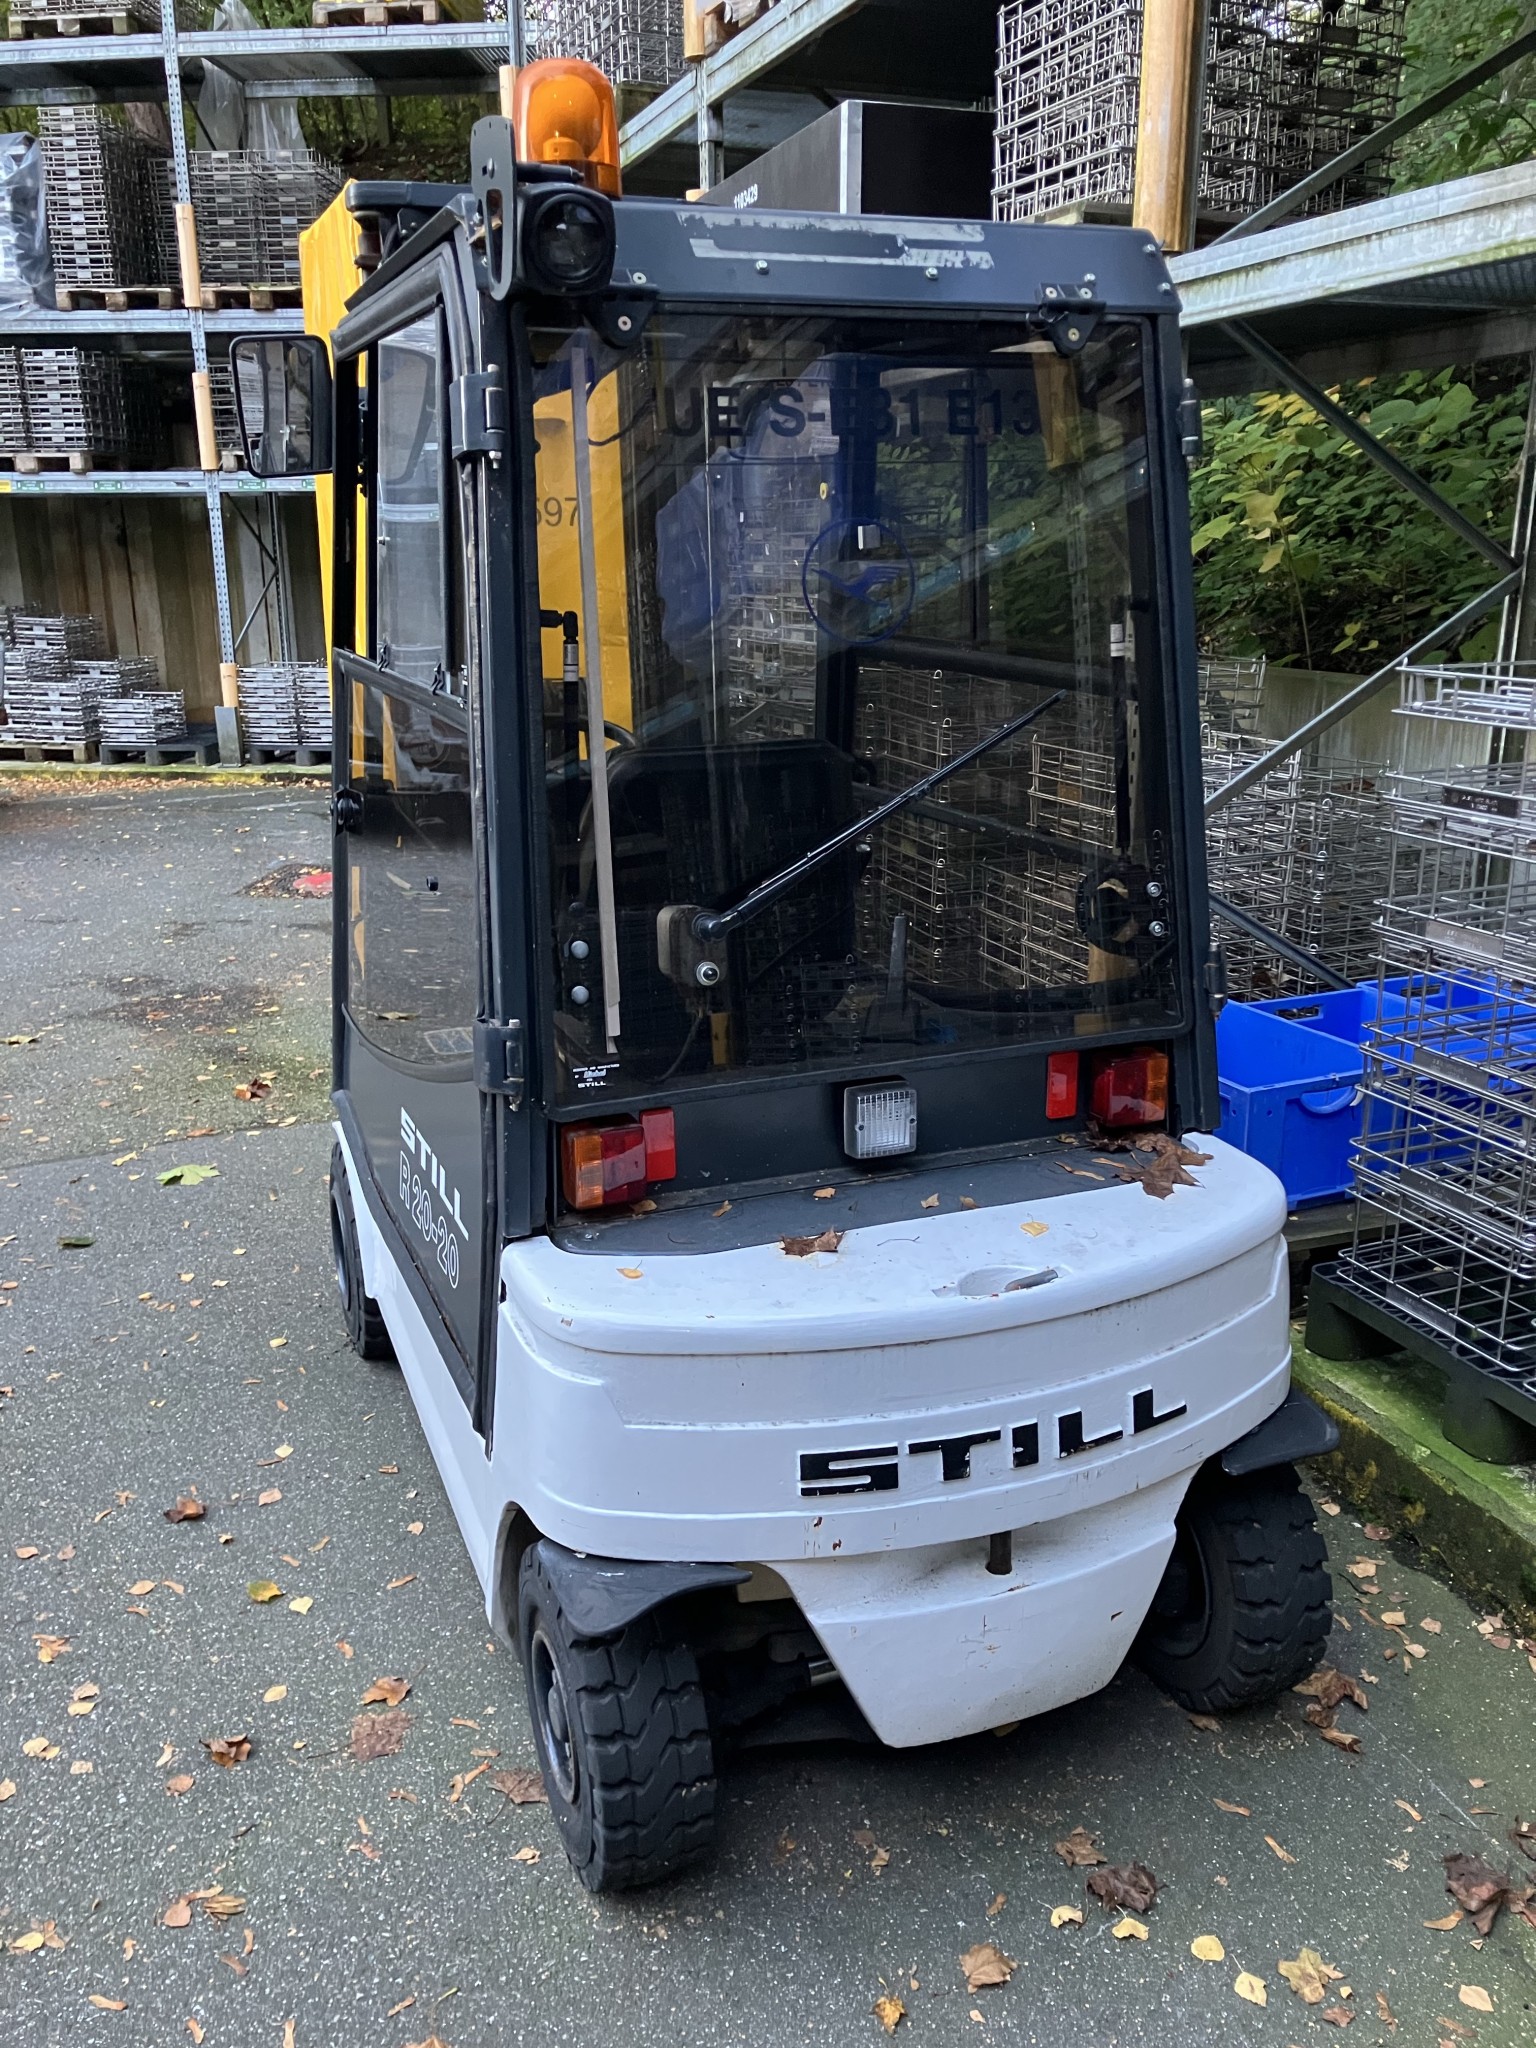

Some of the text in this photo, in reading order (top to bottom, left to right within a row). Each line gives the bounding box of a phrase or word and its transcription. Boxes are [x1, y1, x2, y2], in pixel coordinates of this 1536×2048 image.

[947, 388, 1040, 436] E13
[536, 496, 578, 527] 97
[577, 1081, 607, 1089] STILL
[401, 1106, 469, 1241] STILL
[400, 1150, 460, 1289] R 20-20
[799, 1386, 1189, 1497] STILL
